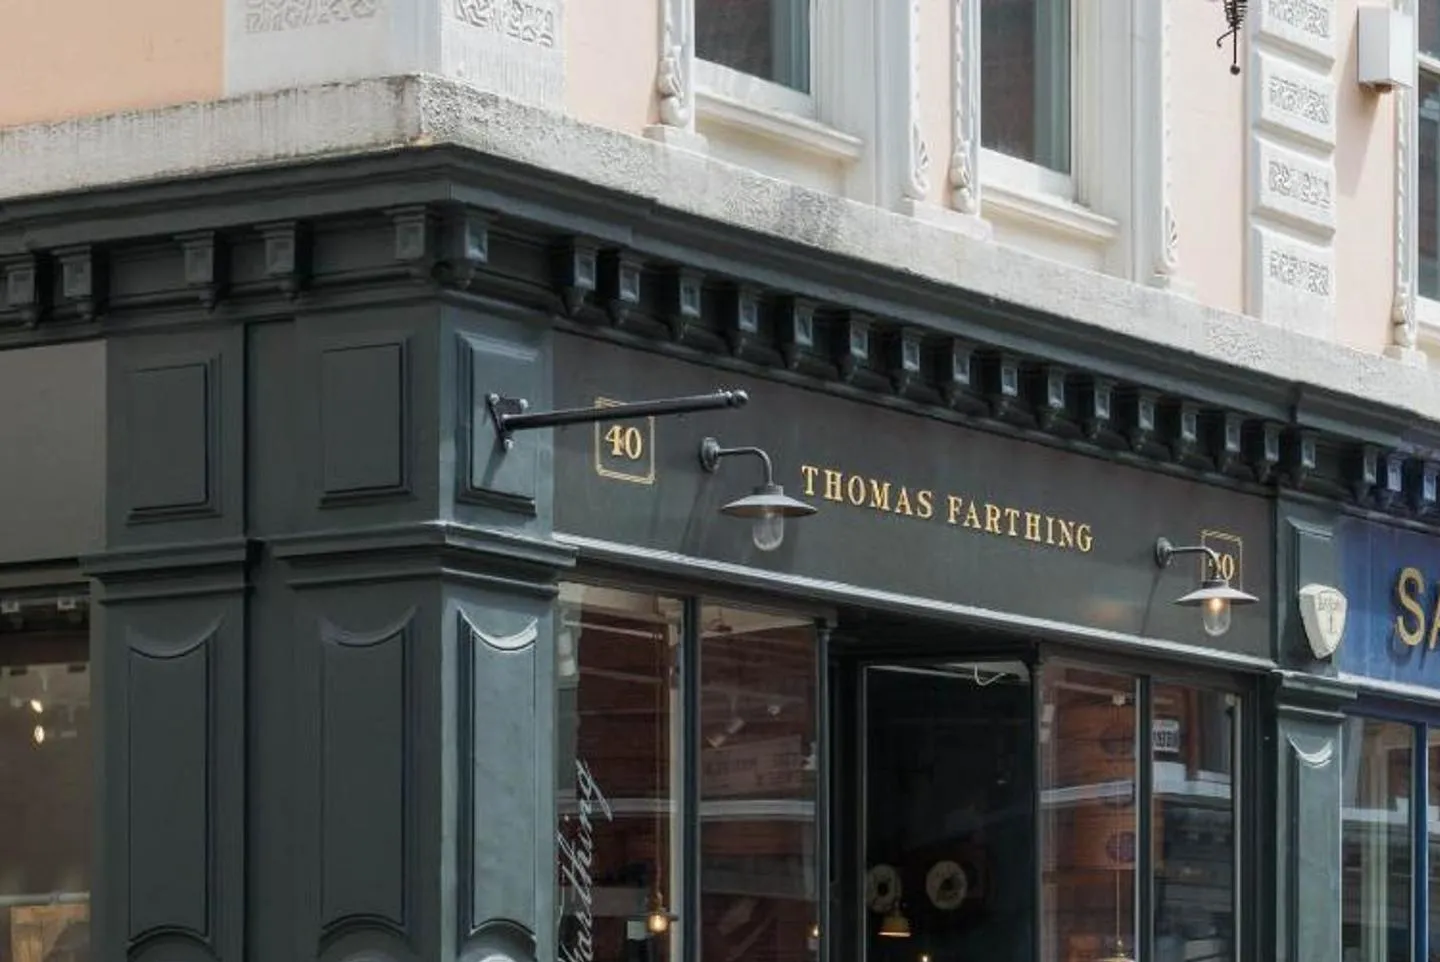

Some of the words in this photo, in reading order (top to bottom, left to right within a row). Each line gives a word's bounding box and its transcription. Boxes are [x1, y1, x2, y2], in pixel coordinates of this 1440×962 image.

[604, 424, 642, 460] 40
[801, 465, 934, 519] THOMAS
[947, 494, 1093, 552] FARTHING
